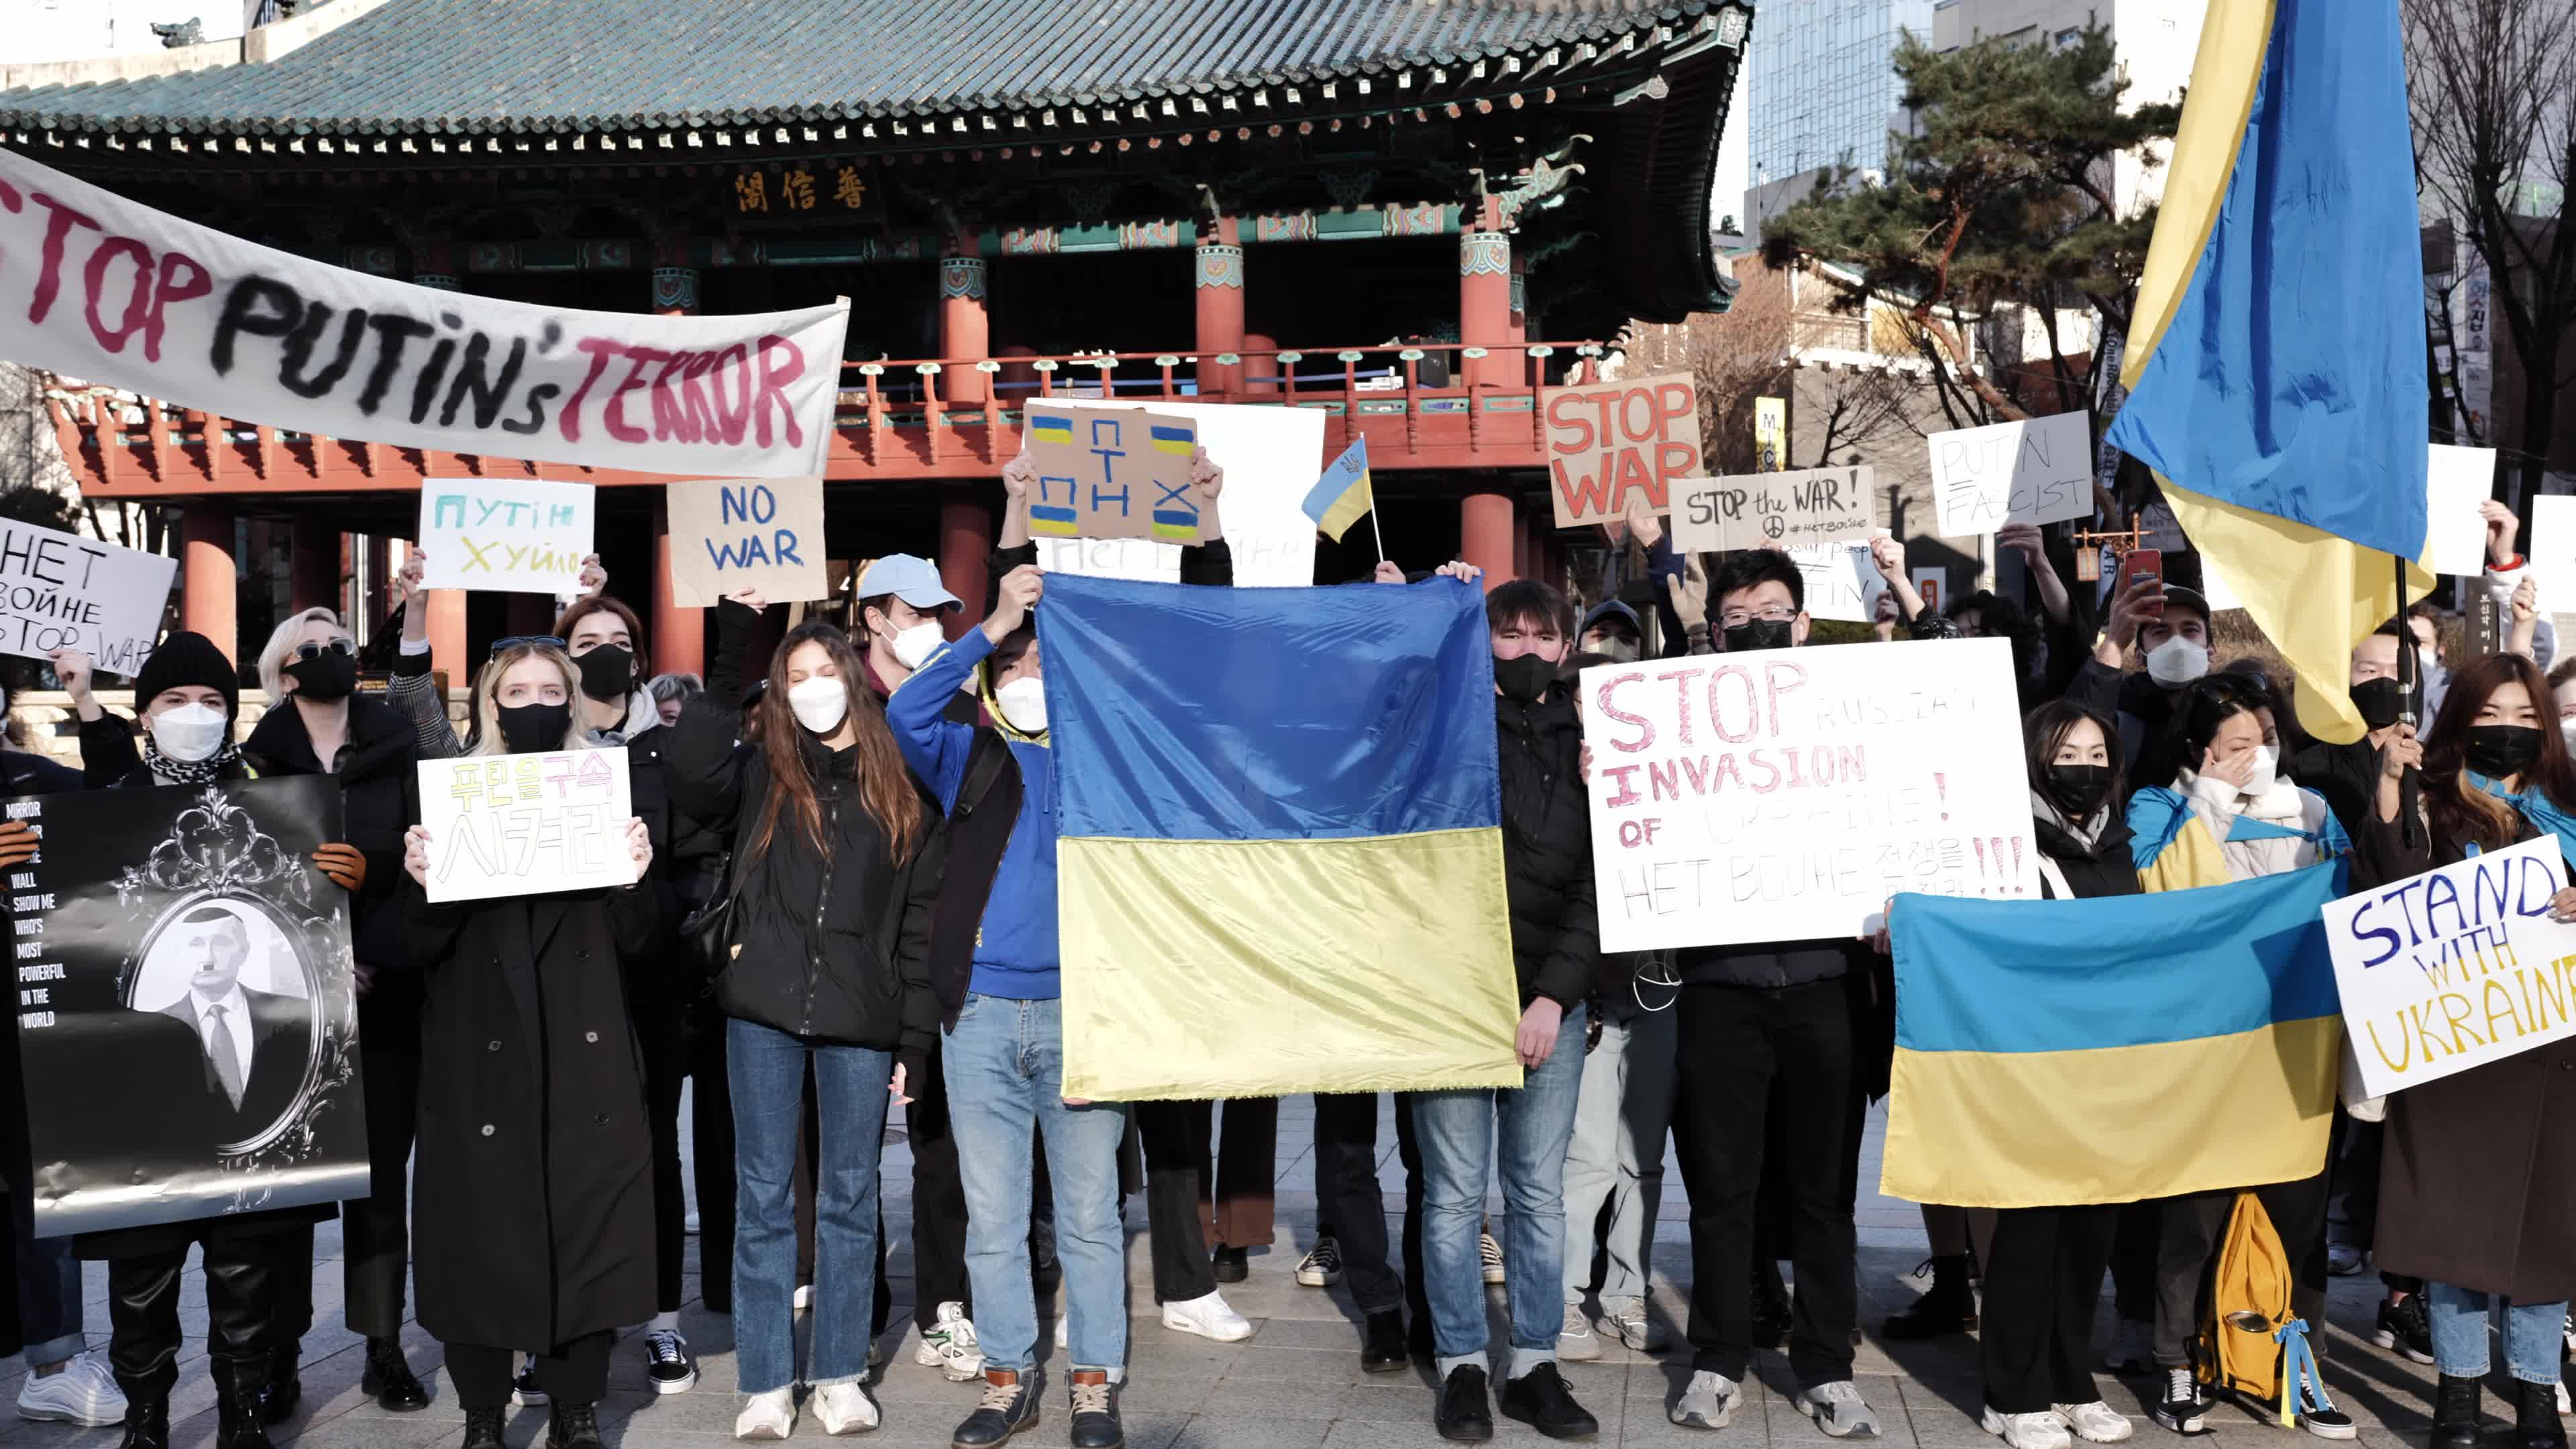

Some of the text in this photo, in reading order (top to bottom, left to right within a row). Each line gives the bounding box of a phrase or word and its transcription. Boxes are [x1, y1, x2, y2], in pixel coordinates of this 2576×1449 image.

[558, 334, 806, 448] TERROR
[1546, 382, 1695, 454] STOP
[1552, 441, 1698, 519] WAR
[720, 484, 776, 525] NO
[1686, 488, 1748, 525] STOP
[1754, 490, 1788, 515] the
[0, 529, 107, 590] НЕТ
[705, 529, 804, 571] WAR
[1597, 660, 1808, 753] STOP
[1602, 744, 1868, 808] INVASION
[6, 801, 42, 819] MIRROR
[1618, 817, 1662, 849] OF
[11, 872, 37, 889] WALL
[1618, 858, 1712, 920] НЕТ
[13, 894, 56, 912] SHOW ME
[2351, 855, 2557, 969] STAND
[15, 918, 44, 935] WHO'S
[17, 942, 42, 959] MOST
[2413, 921, 2518, 991] WITH
[19, 963, 66, 983] POWERFUL
[21, 988, 49, 1006] IN THE
[23, 1011, 55, 1029] WORLD
